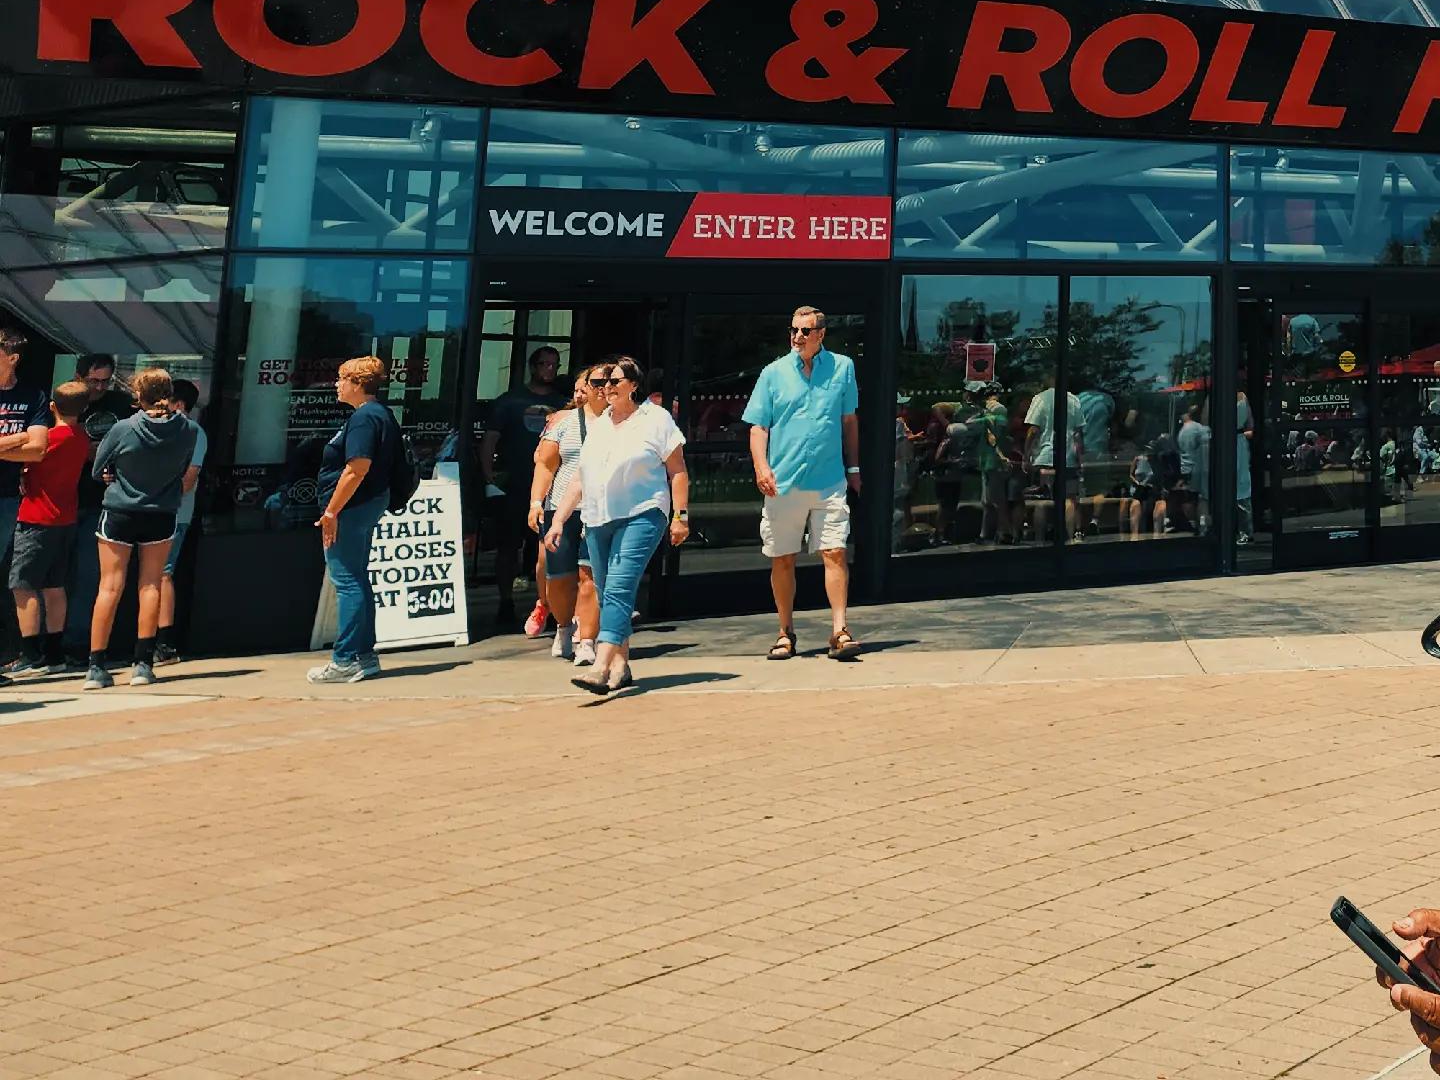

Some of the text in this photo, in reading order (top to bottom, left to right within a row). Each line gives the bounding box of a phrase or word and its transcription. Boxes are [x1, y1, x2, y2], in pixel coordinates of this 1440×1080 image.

[948, 1, 1347, 128] ROLL
[488, 209, 666, 237] WELCOME
[693, 214, 888, 241] ENTER HERE
[259, 359, 292, 370] GET
[1299, 395, 1321, 403] ROCK
[1329, 394, 1350, 402] ROLL
[231, 467, 267, 476] NOTICE
[375, 520, 441, 540] HALL
[369, 540, 456, 563] CLOSES
[368, 563, 452, 586] TODAY
[373, 587, 454, 614] AT 5:00
